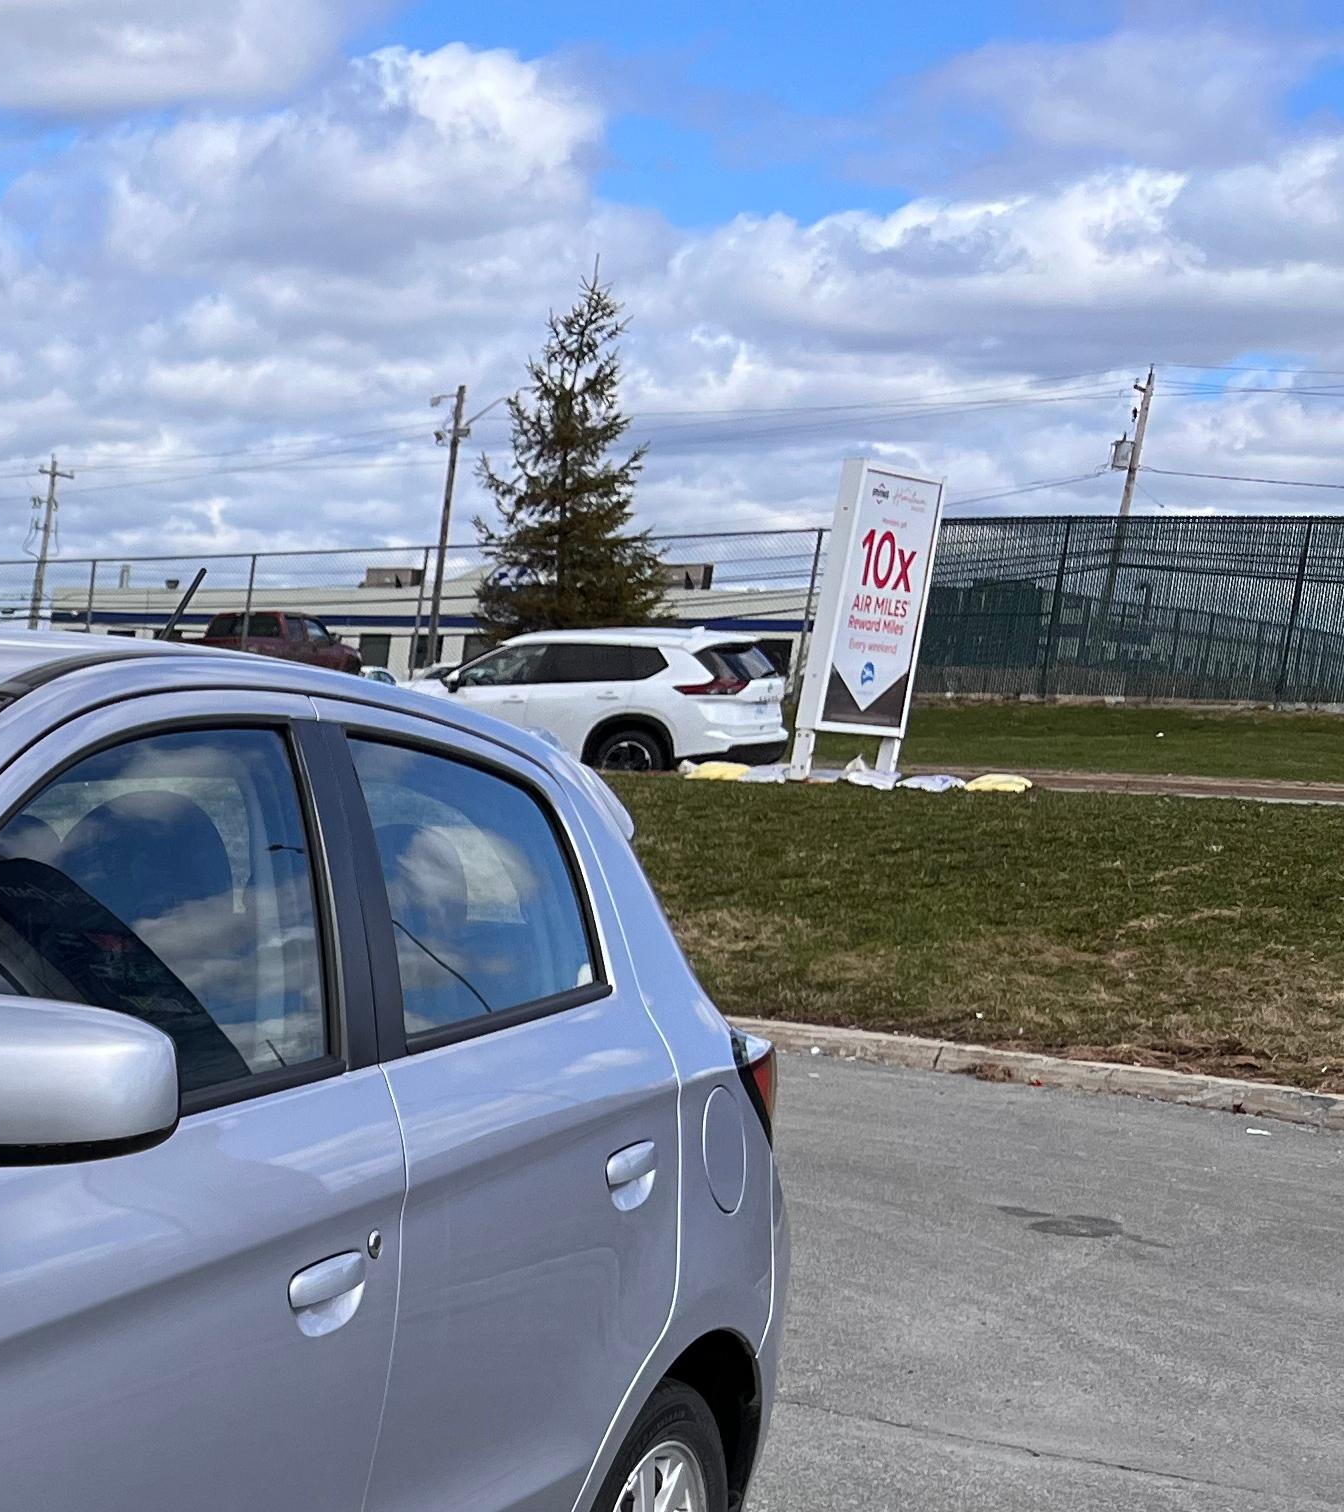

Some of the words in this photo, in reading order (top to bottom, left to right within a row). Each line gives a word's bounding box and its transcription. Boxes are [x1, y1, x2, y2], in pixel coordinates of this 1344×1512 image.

[862, 528, 917, 593] 10x
[852, 593, 872, 613] AIR
[874, 597, 907, 617] MILES
[847, 614, 881, 633] Reward
[882, 619, 904, 636] Miles
